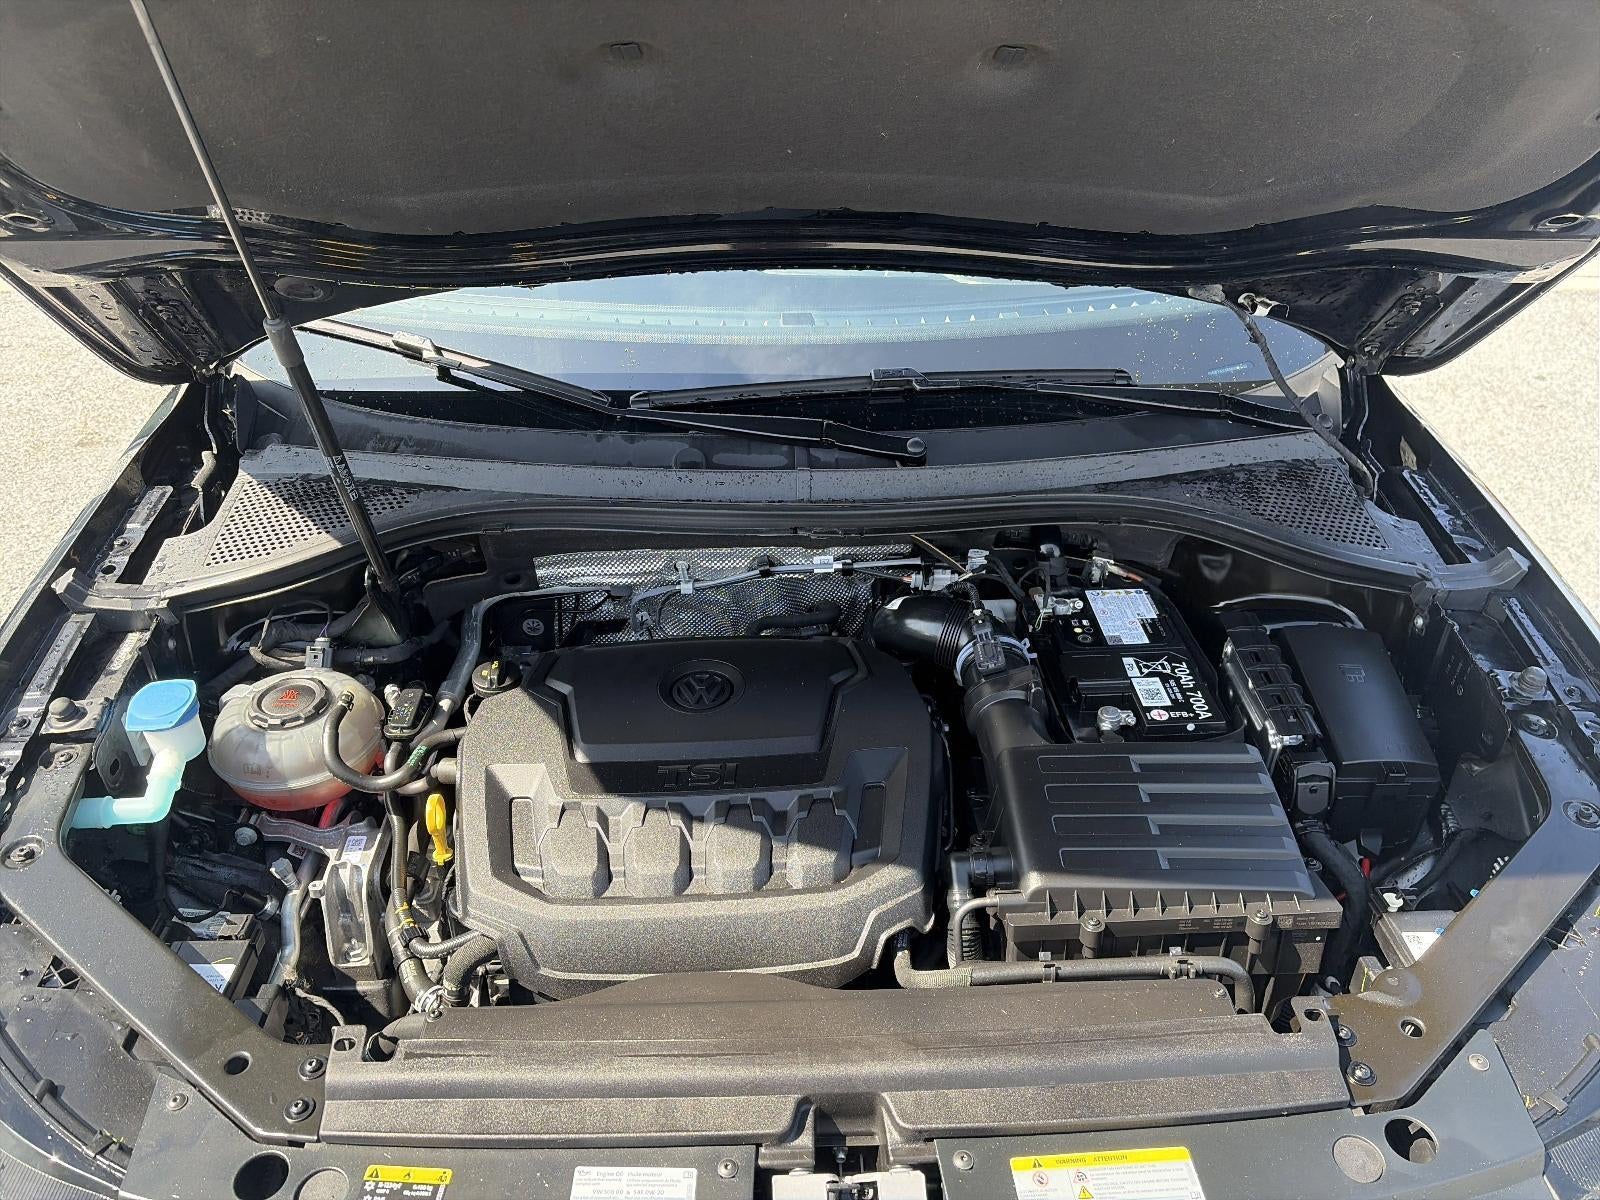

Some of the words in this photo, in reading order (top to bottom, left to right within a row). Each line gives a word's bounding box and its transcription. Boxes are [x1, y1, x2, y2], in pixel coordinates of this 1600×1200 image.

[1172, 661, 1194, 689] 70Ah
[1186, 690, 1213, 720] 700A
[657, 762, 740, 787] TSI
[1055, 1158, 1087, 1166] WARNING
[1093, 1154, 1128, 1163] ATTENTION
